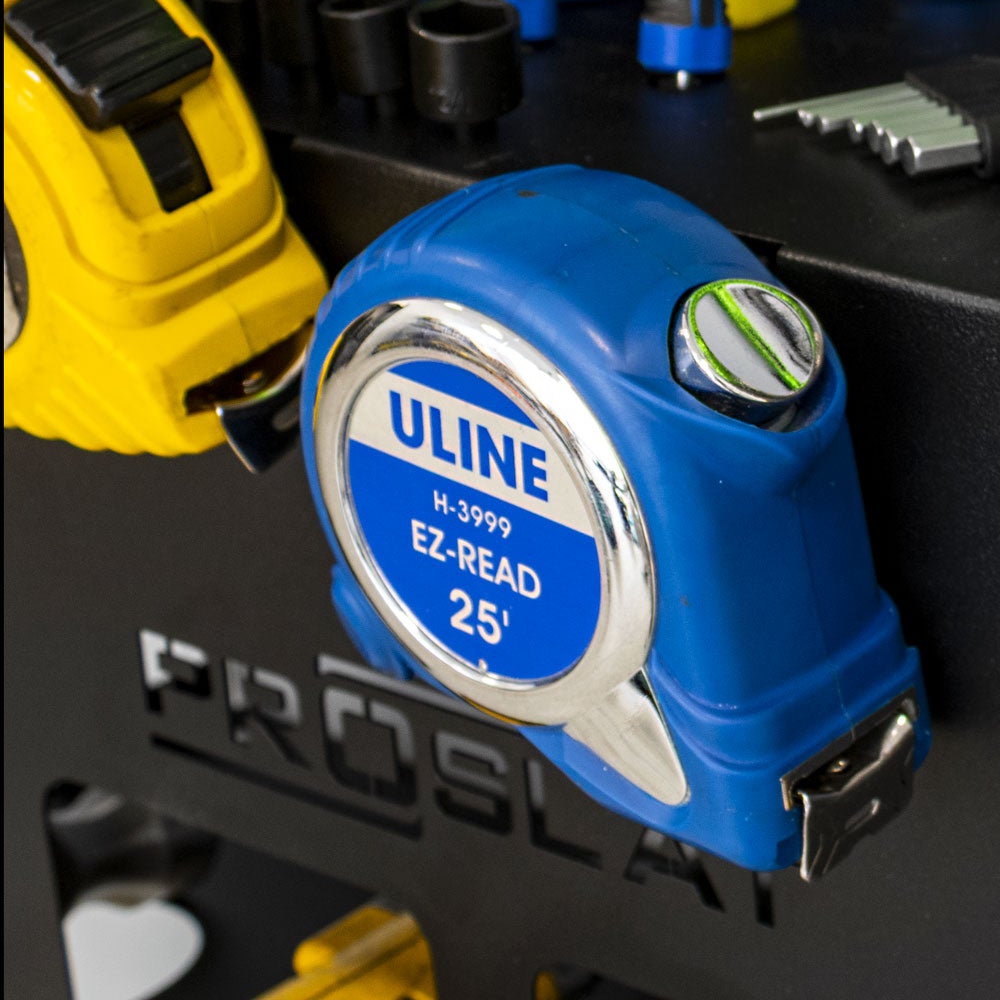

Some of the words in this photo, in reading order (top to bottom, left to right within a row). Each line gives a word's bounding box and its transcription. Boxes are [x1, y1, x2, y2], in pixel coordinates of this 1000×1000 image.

[389, 390, 549, 503] ULINE
[433, 490, 511, 540] H-3999
[411, 519, 541, 600] EZ-READ
[449, 588, 509, 645] 25'
